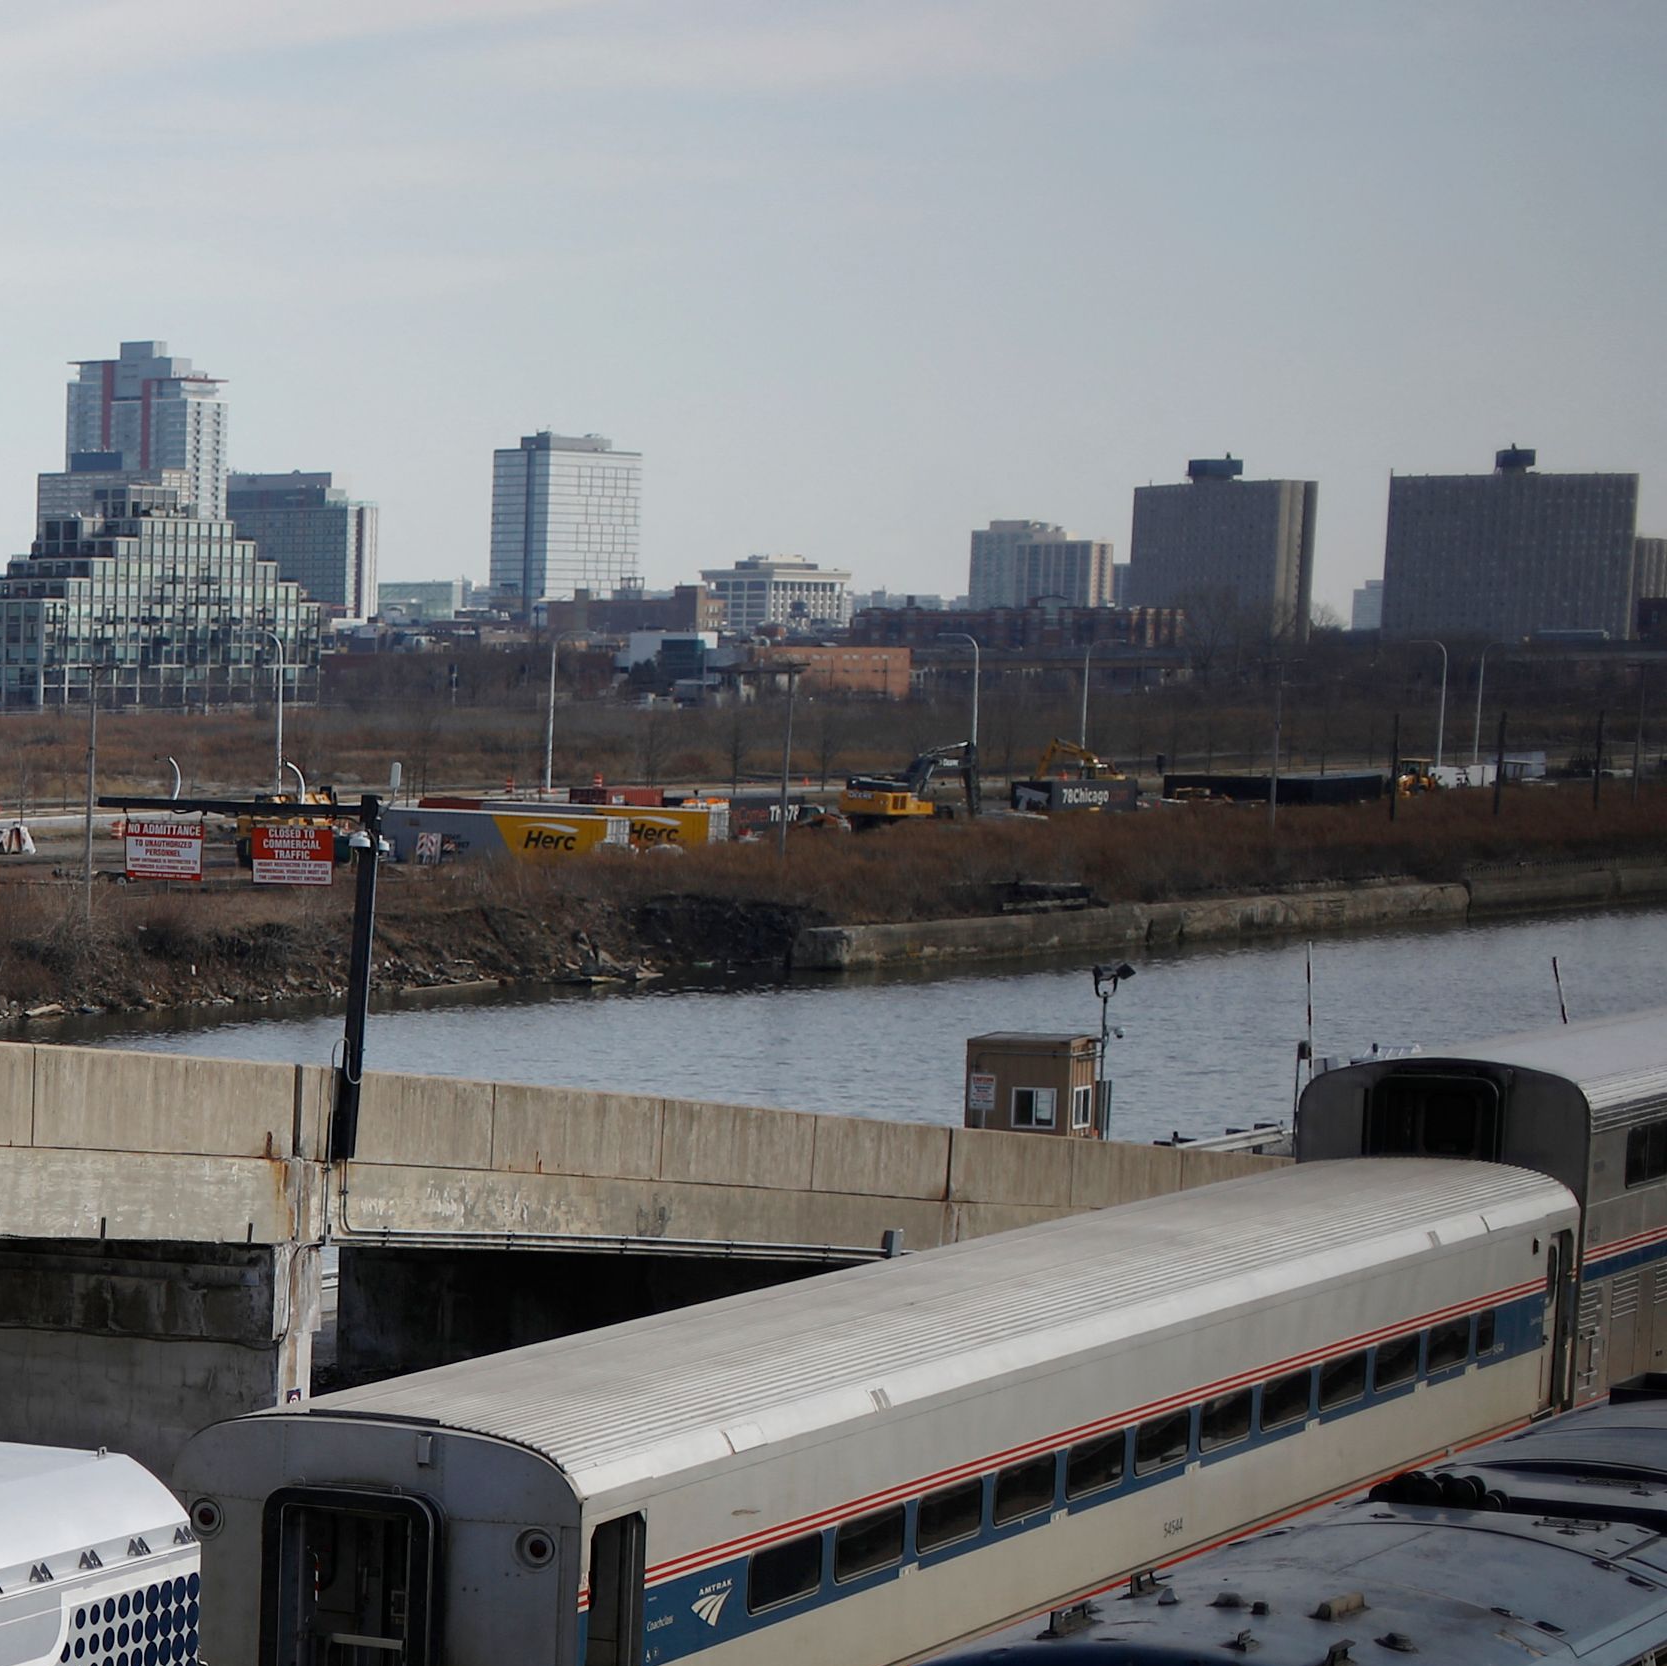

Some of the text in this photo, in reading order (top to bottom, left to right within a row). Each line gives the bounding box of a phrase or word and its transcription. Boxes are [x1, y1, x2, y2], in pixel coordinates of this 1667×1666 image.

[128, 823, 201, 836] NO ADMITTANCE
[269, 829, 315, 839] CLOSED TO
[631, 823, 679, 842] Herc
[135, 839, 193, 849] TO UNAUTHORIZED
[263, 839, 321, 850] COMMERCIAL
[523, 831, 576, 850] Herc
[145, 848, 181, 857] PERSONNEL
[274, 850, 310, 859] TRAFFIC
[698, 1578, 733, 1596] AMTRAK
